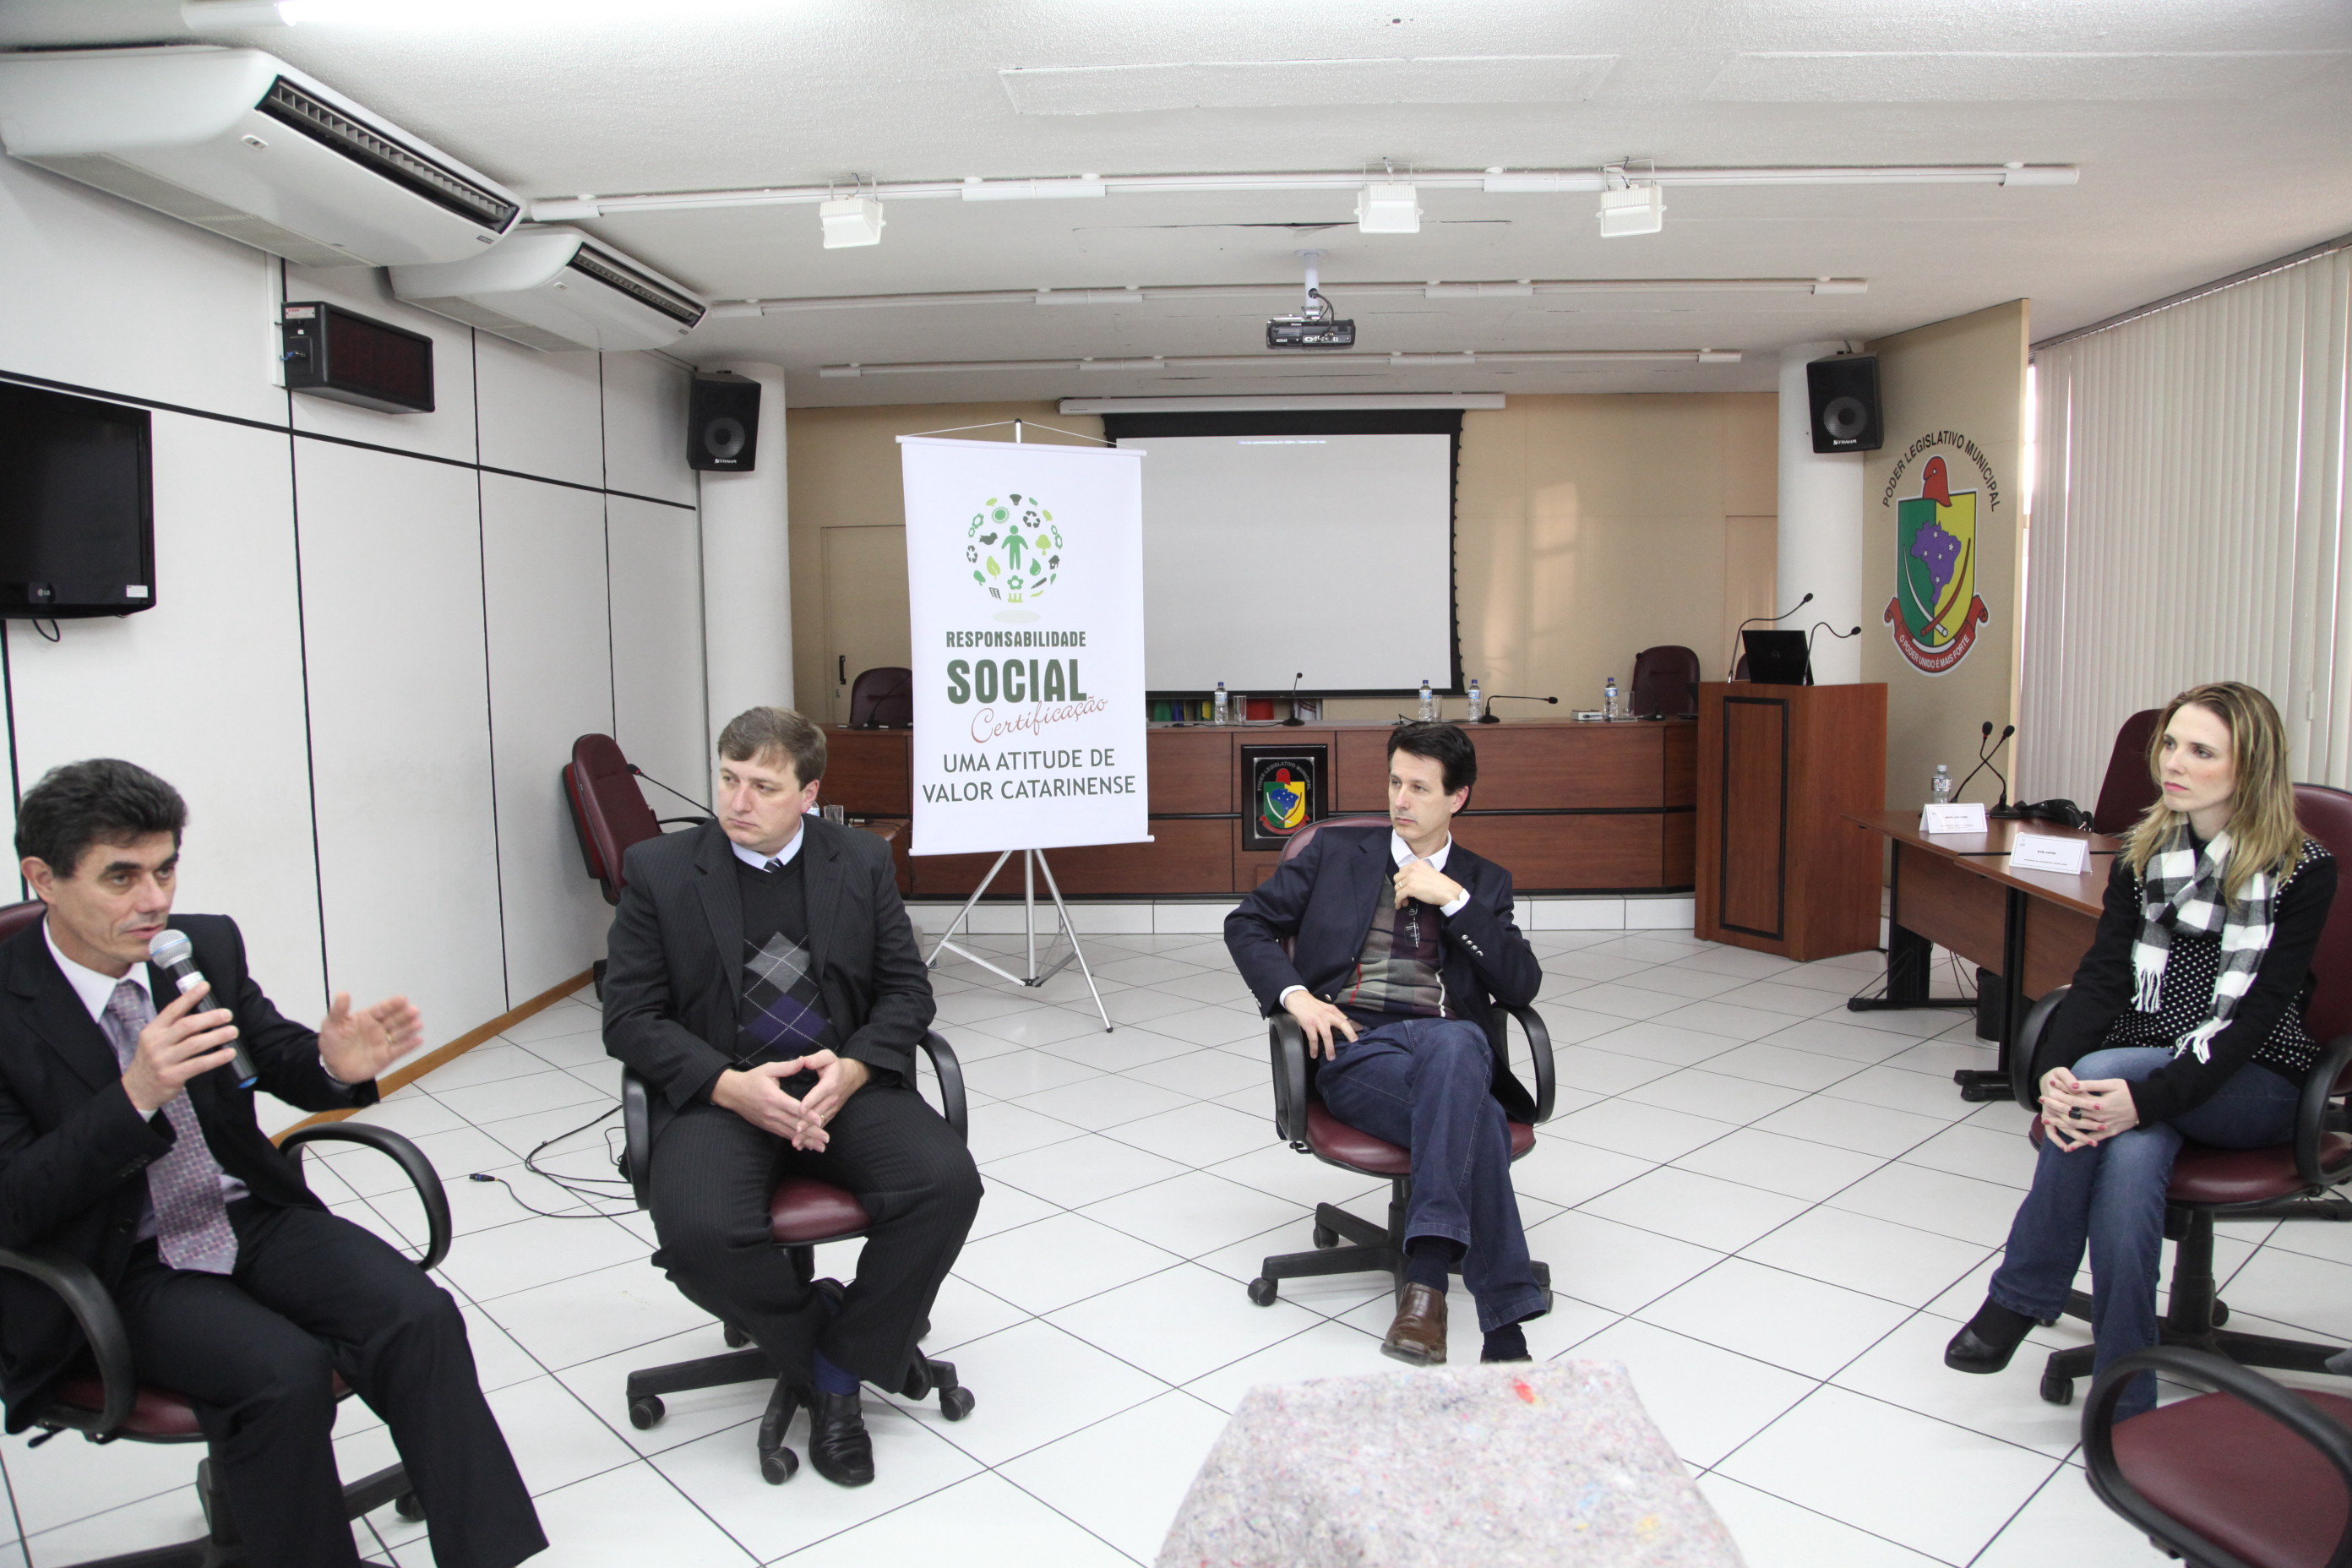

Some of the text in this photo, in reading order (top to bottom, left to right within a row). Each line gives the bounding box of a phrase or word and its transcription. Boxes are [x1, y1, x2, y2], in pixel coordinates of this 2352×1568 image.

[1882, 430, 2001, 512] PODER LEGISLATIVO MUNICIPAL
[946, 631, 1086, 648] RESPONSABILIDADE
[1899, 634, 1970, 668] O PODER UNIDO É MAIS FORTE
[947, 658, 1087, 705] SOCIAL
[971, 695, 1108, 743] Certificação
[944, 749, 1115, 773] UMA ATITUDE DE
[1257, 761, 1311, 792] PODER LEGISLATIVO MUNICIPAL
[923, 775, 1136, 803] VALOR CATARINENSE
